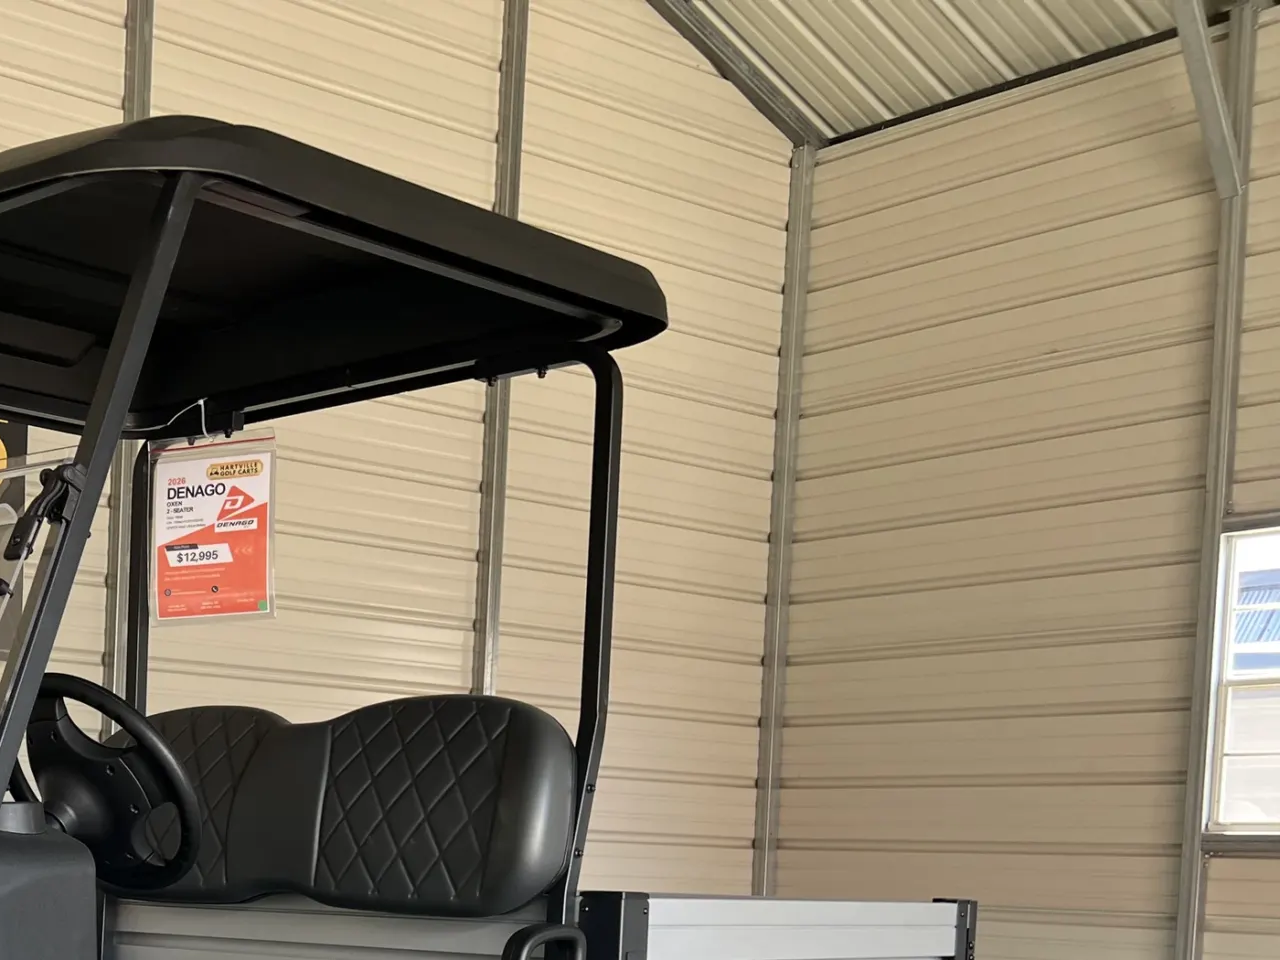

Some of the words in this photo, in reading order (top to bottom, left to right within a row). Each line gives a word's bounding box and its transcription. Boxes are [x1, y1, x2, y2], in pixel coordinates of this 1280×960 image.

[220, 462, 258, 471] HARTVILLE
[220, 469, 236, 477] GOLF
[238, 467, 258, 475] CARTS
[167, 482, 226, 500] DENAGO
[173, 506, 194, 514] SEATER
[216, 519, 255, 528] DENAGO
[176, 550, 219, 563] $12,995
